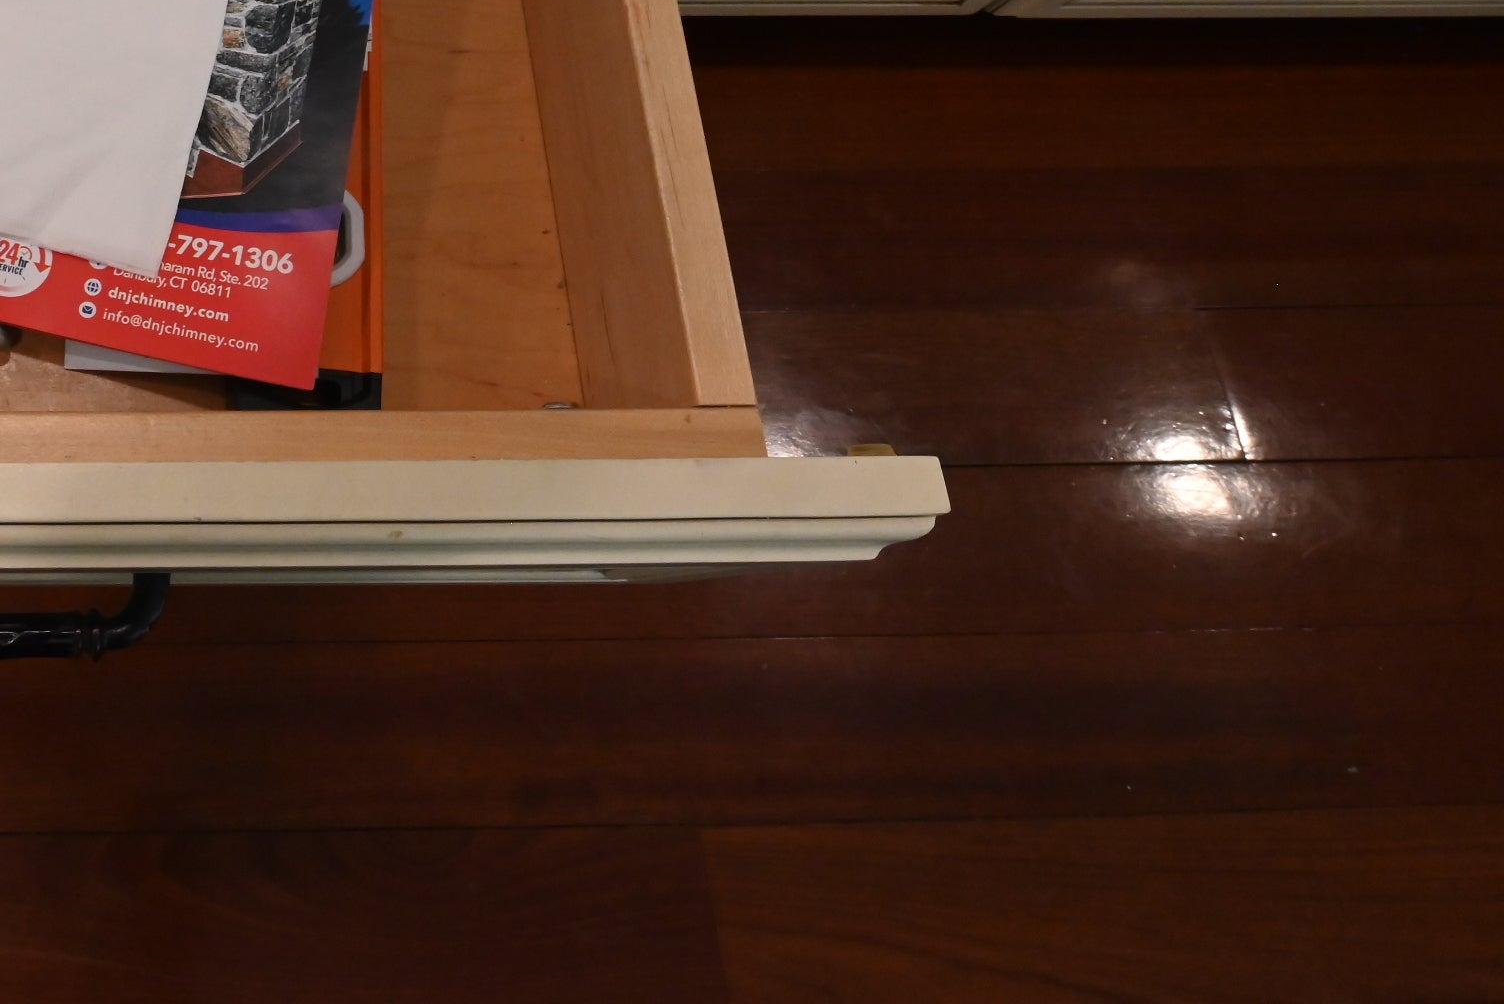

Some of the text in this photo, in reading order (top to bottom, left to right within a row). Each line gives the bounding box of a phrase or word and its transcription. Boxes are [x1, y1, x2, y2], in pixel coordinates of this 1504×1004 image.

[170, 276, 188, 289] CT
[192, 280, 231, 298] 06811
[197, 266, 218, 282] Rd,
[219, 270, 242, 285] Ste.
[244, 274, 269, 290] 202
[108, 286, 229, 322] dnjchimney.com
[103, 308, 259, 352] info@dnjchimney.com
